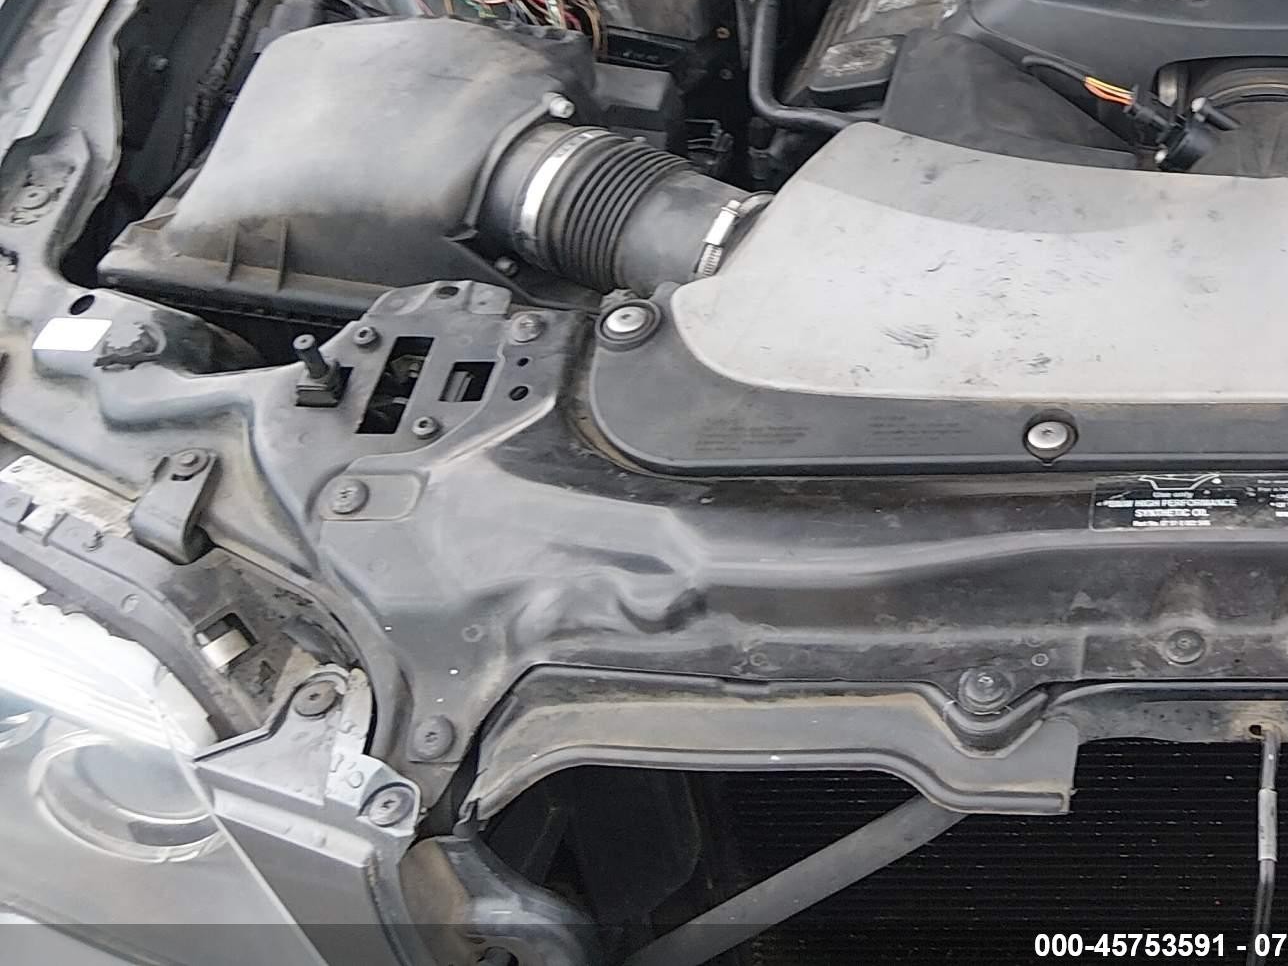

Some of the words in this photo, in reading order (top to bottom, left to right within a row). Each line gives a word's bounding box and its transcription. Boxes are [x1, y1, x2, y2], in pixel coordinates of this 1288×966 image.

[1161, 498, 1237, 507] PERFORMANCE
[1134, 508, 1192, 518] SYNTHETIC
[1191, 508, 1210, 517] OIL
